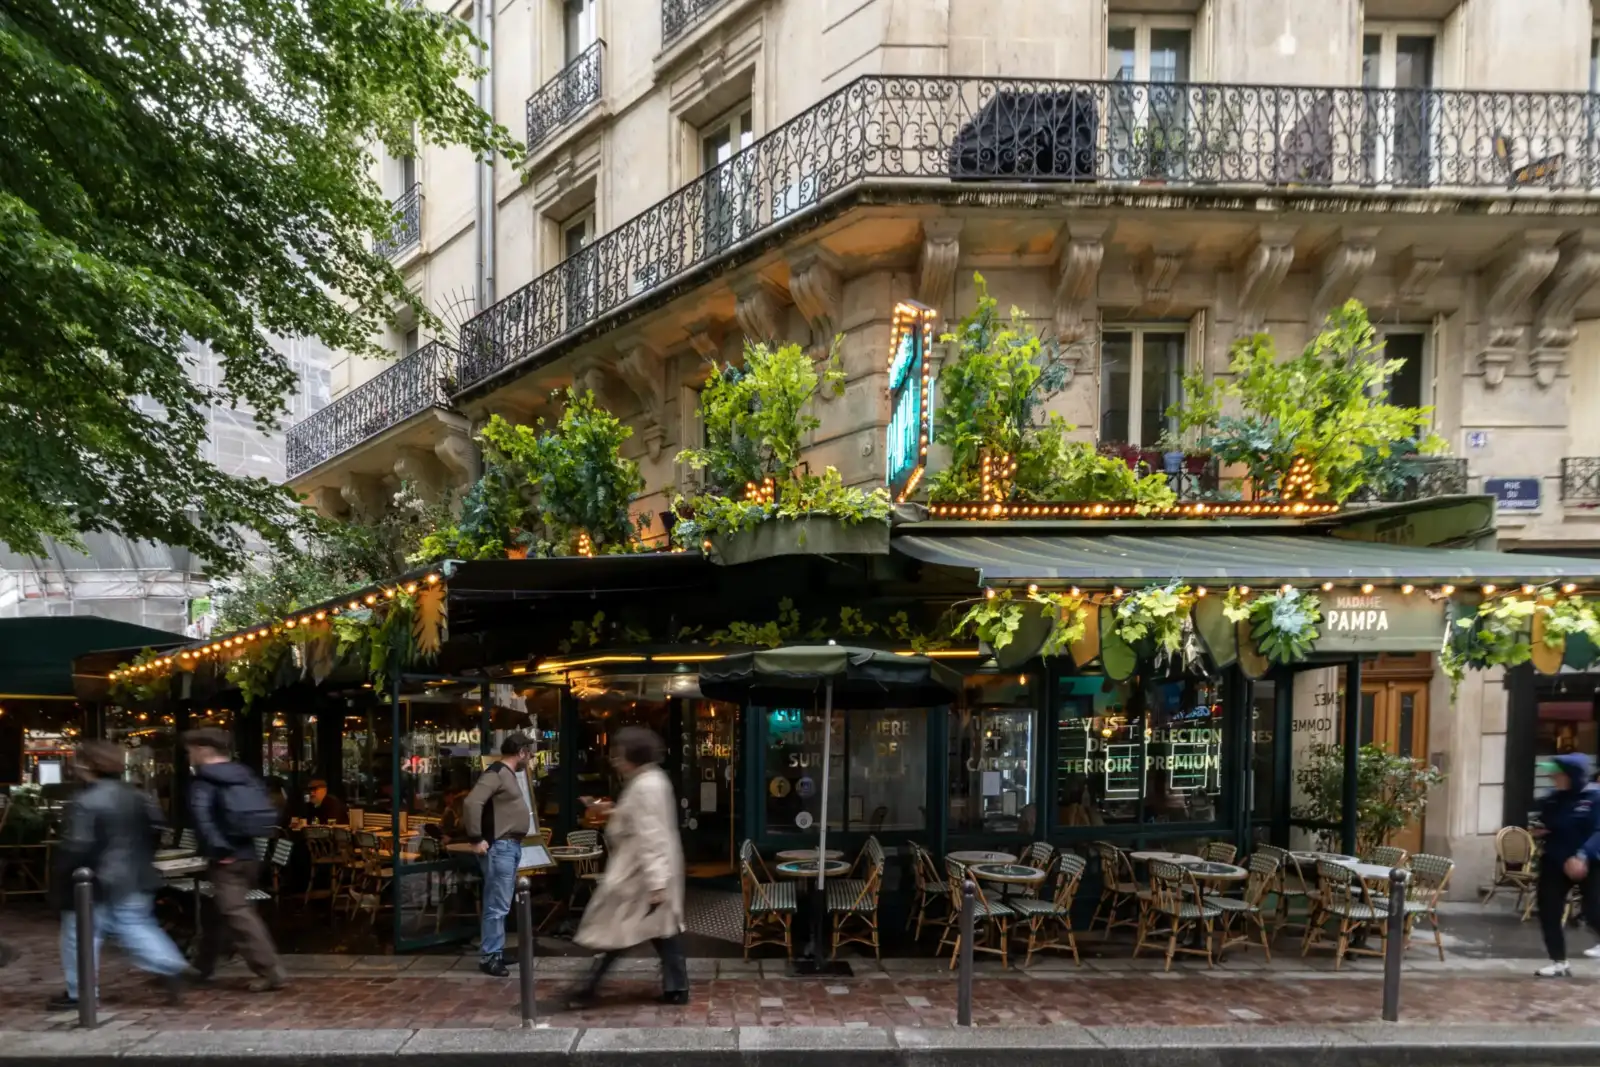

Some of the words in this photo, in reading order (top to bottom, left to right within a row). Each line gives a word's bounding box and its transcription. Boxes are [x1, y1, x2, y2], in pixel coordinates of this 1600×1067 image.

[1336, 596, 1381, 609] MADAME
[1327, 610, 1388, 631] PAMPA
[1087, 737, 1108, 752] DE
[788, 752, 821, 768] SUR
[1064, 758, 1132, 774] TERROIR
[1145, 755, 1218, 771] PREMIUM
